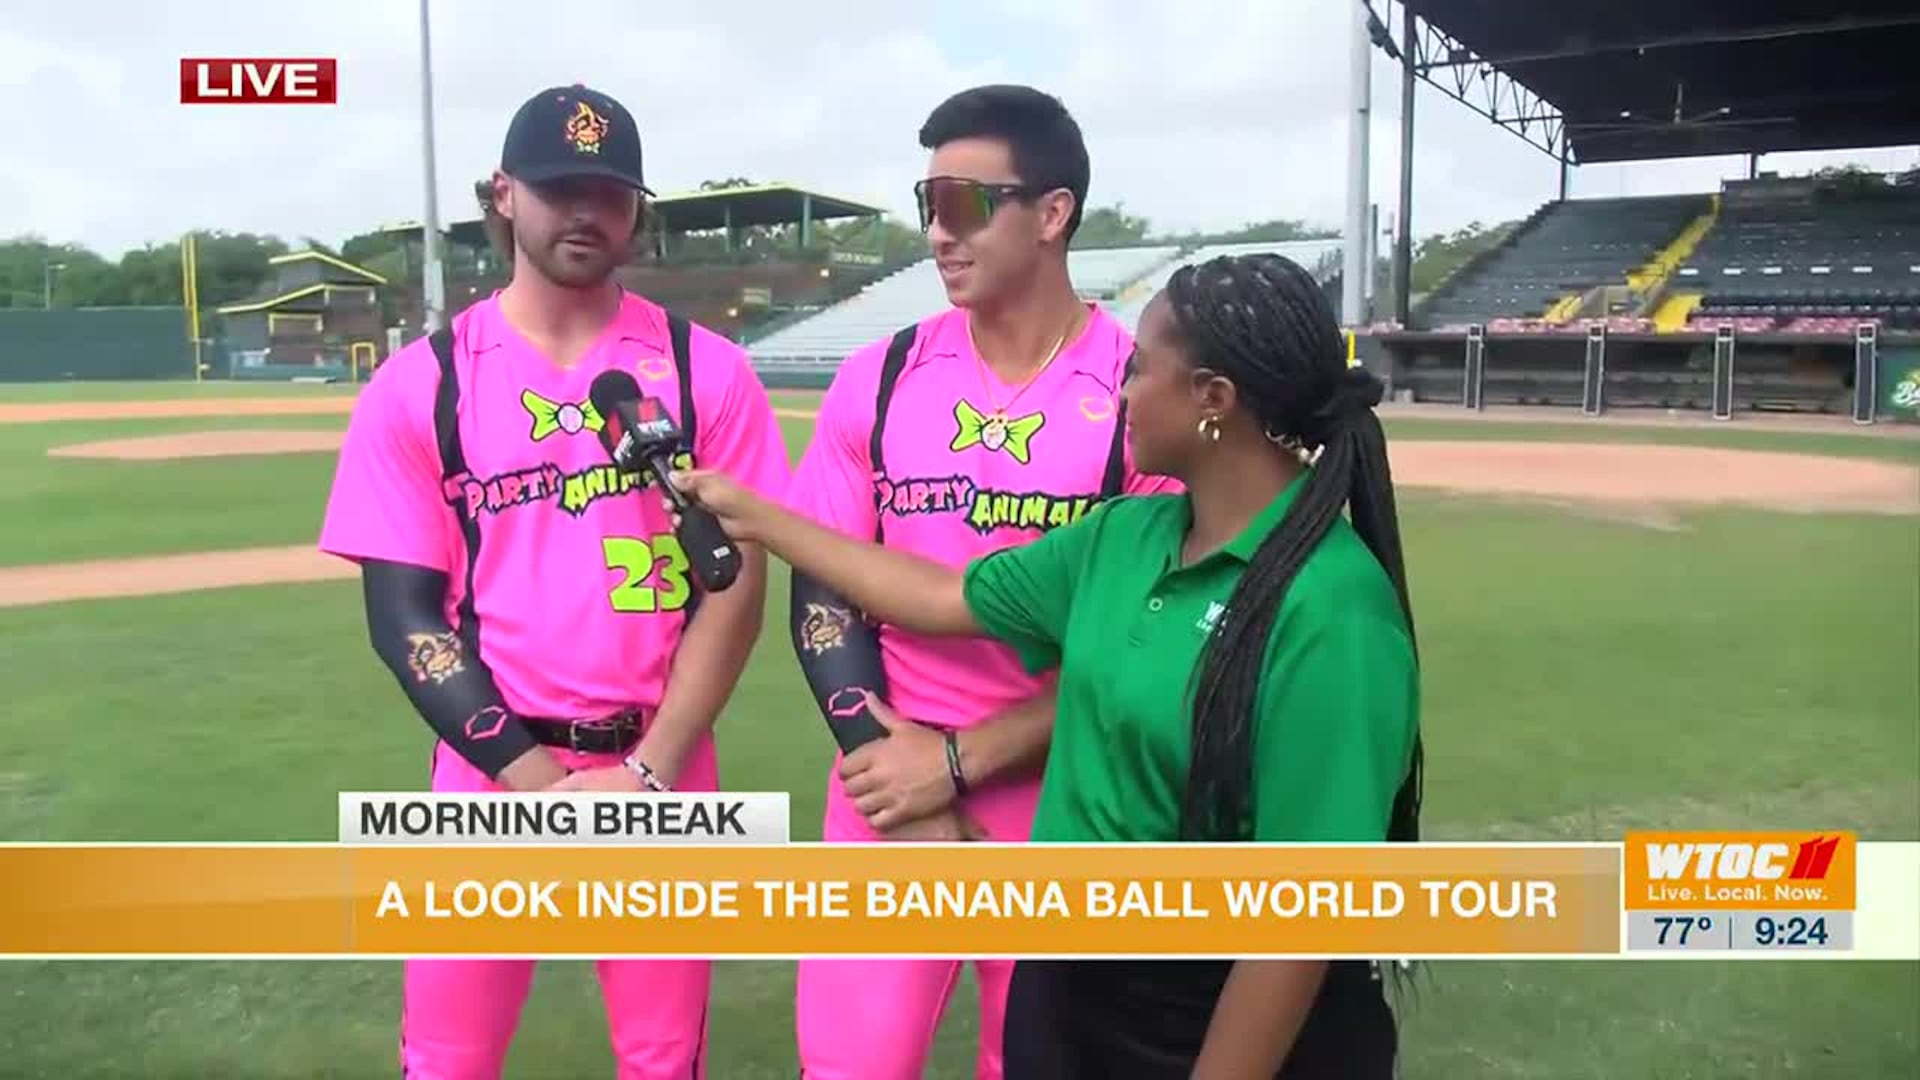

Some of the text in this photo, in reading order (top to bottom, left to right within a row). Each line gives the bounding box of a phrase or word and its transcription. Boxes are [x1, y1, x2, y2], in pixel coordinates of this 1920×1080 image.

[442, 463, 564, 520] PARTY
[873, 474, 1105, 535] PARTY ANIMAL
[602, 533, 692, 613] 23
